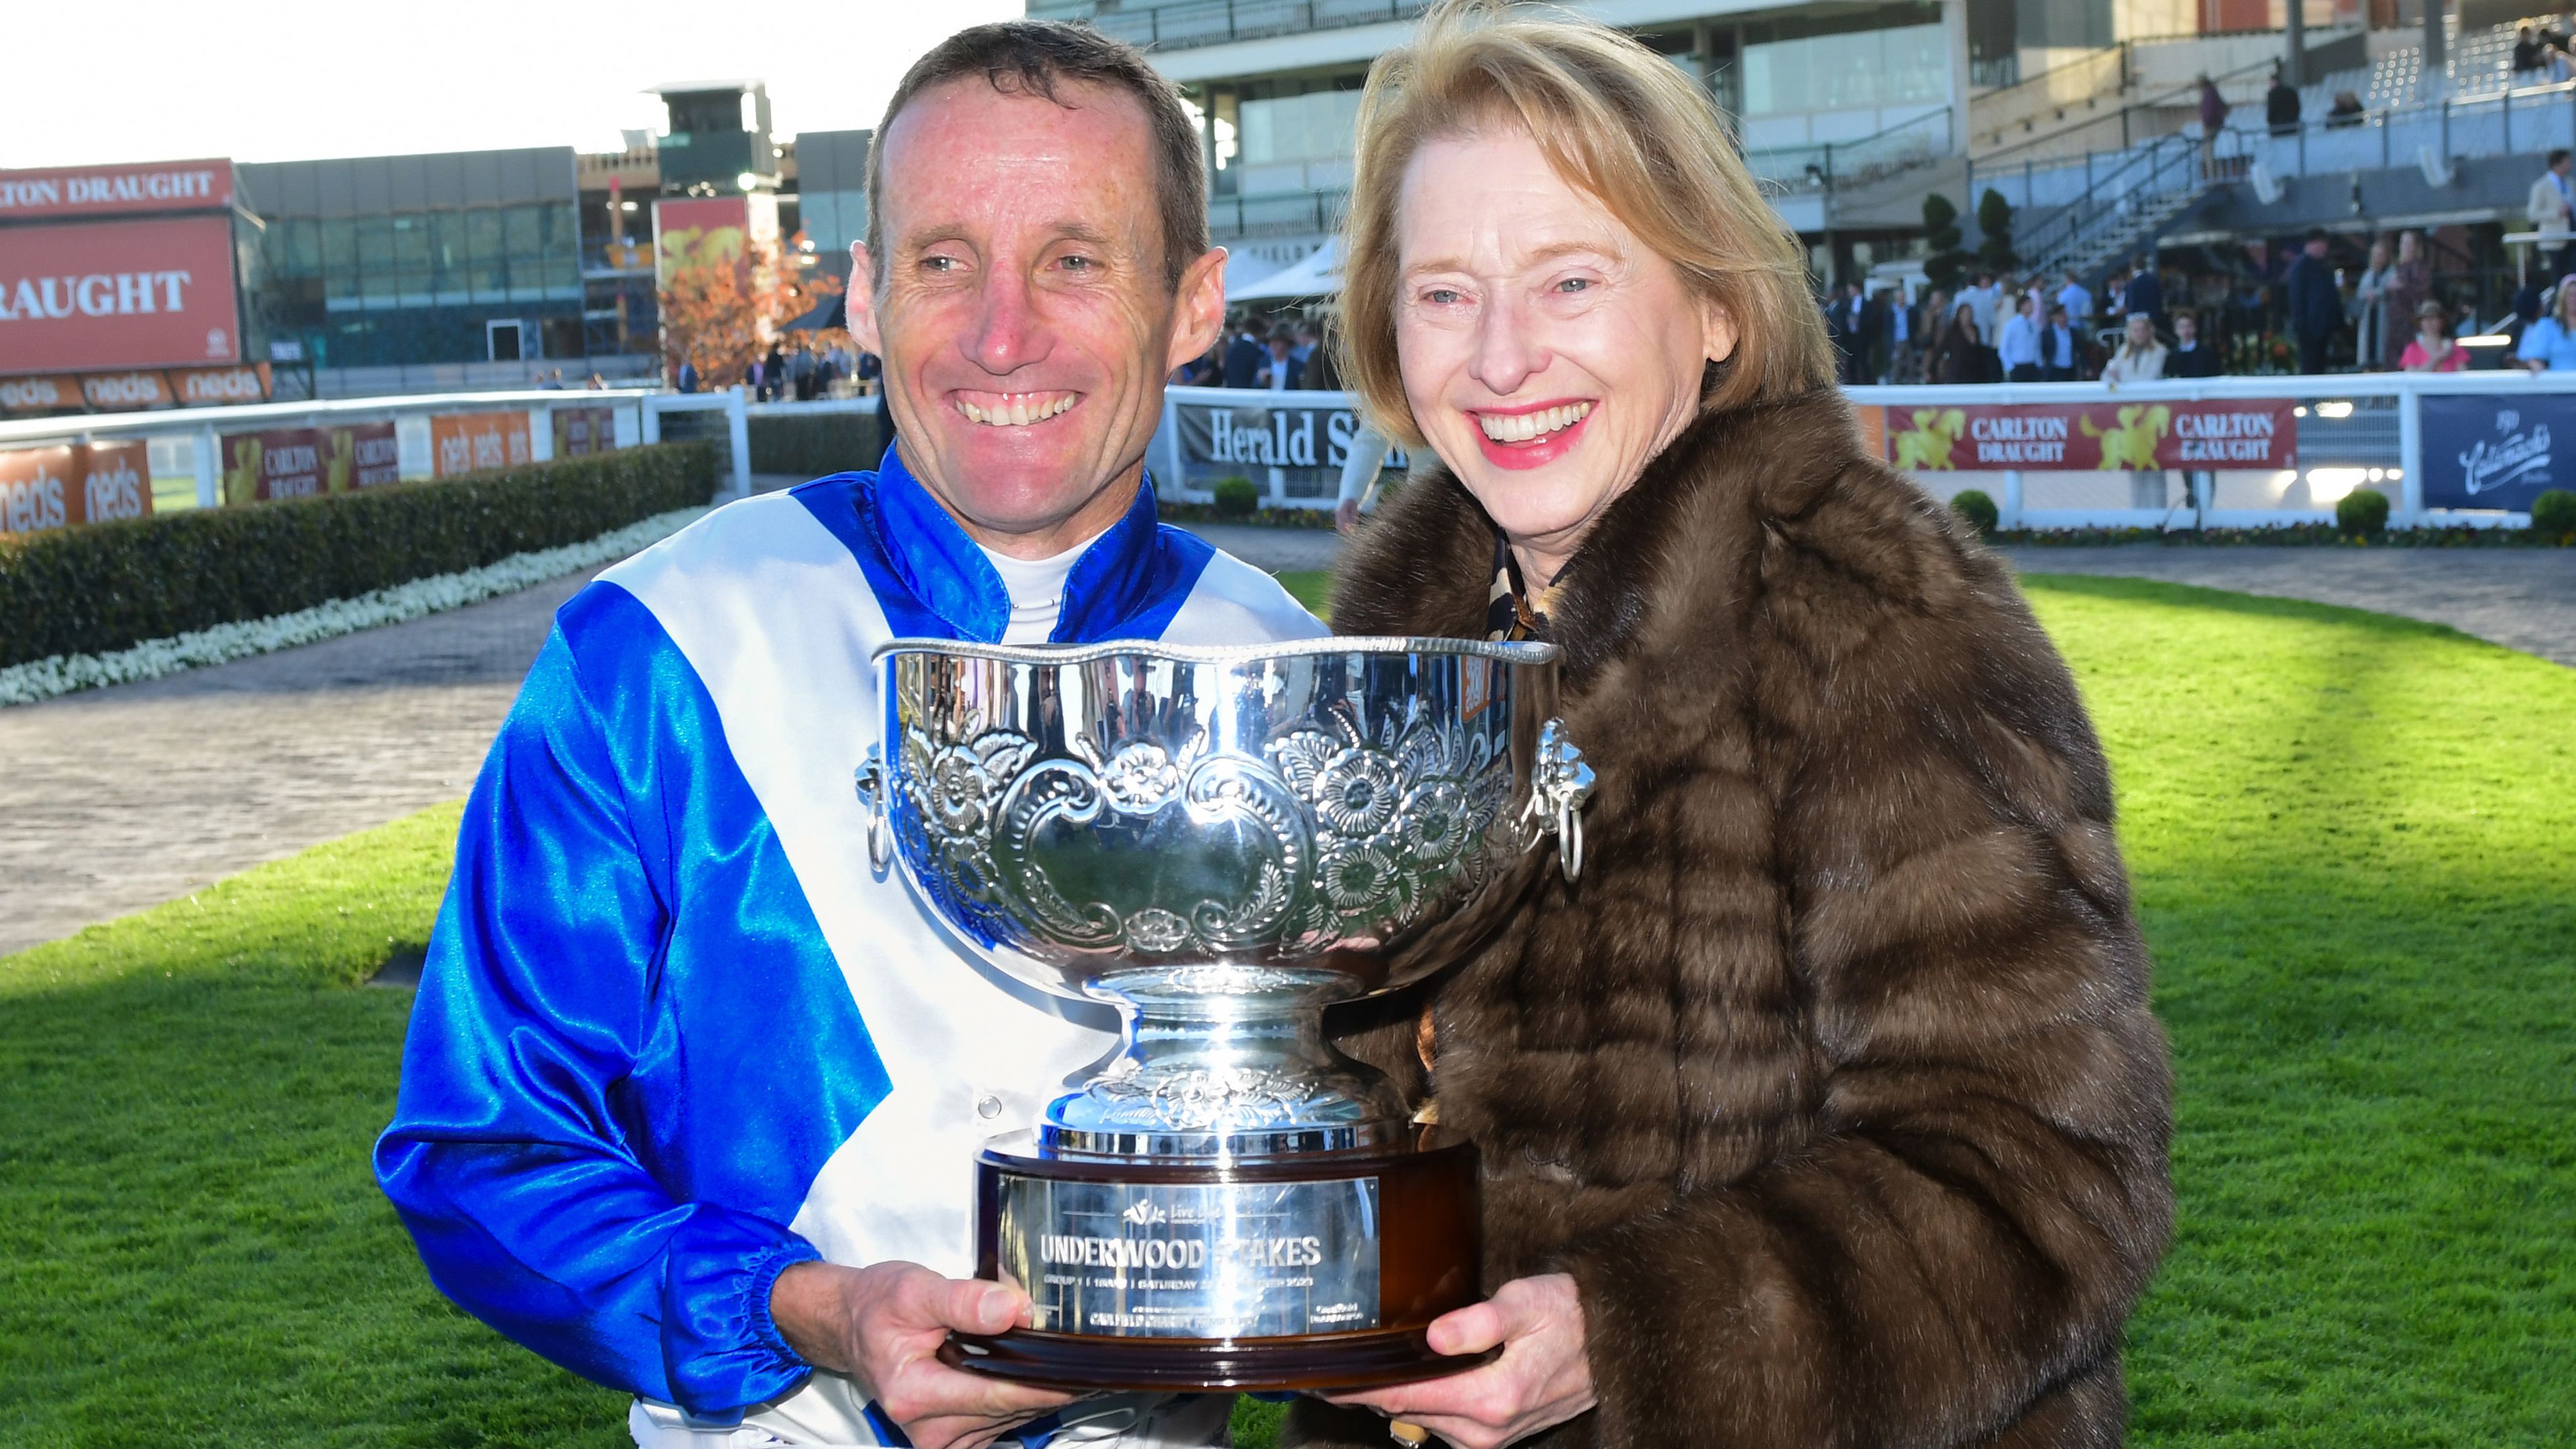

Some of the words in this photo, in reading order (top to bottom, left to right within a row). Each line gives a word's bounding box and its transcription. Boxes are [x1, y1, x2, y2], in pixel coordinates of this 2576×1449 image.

[0, 180, 59, 207] TON
[67, 170, 215, 204] DRAUGHT
[84, 372, 159, 405] neds
[186, 368, 262, 400] neds
[1209, 408, 1318, 466] Herald
[1971, 416, 2068, 441] CARLTON
[2175, 412, 2275, 439] CARLTON
[1978, 441, 2065, 462] DRAUGHT
[2180, 439, 2271, 462] DRAUGHT
[84, 455, 142, 525] neds
[1040, 1234, 1205, 1270] UNDERWOOD
[1043, 1273, 1075, 1286] GROUP
[1138, 1279, 1197, 1291] SATURDAY
